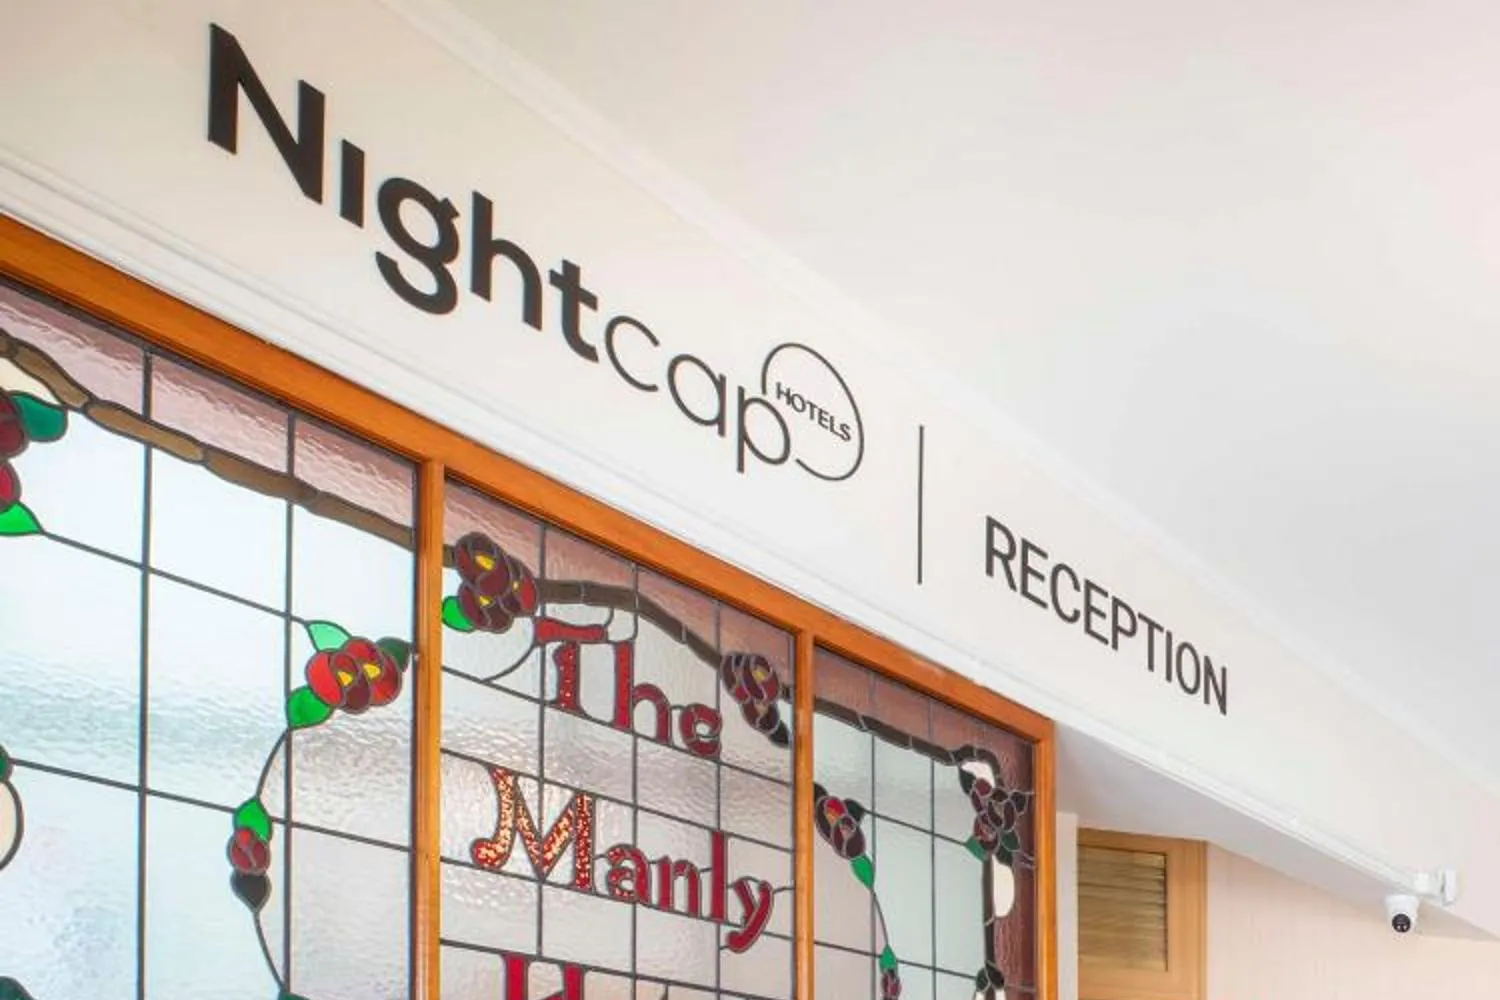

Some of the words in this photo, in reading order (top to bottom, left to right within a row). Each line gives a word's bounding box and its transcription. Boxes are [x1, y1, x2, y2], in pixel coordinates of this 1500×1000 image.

[207, 22, 791, 475] Nightcap
[776, 381, 851, 441] HOTELS
[535, 616, 722, 758] The
[985, 515, 1227, 715] RECEPTION
[470, 767, 773, 953] Manly
